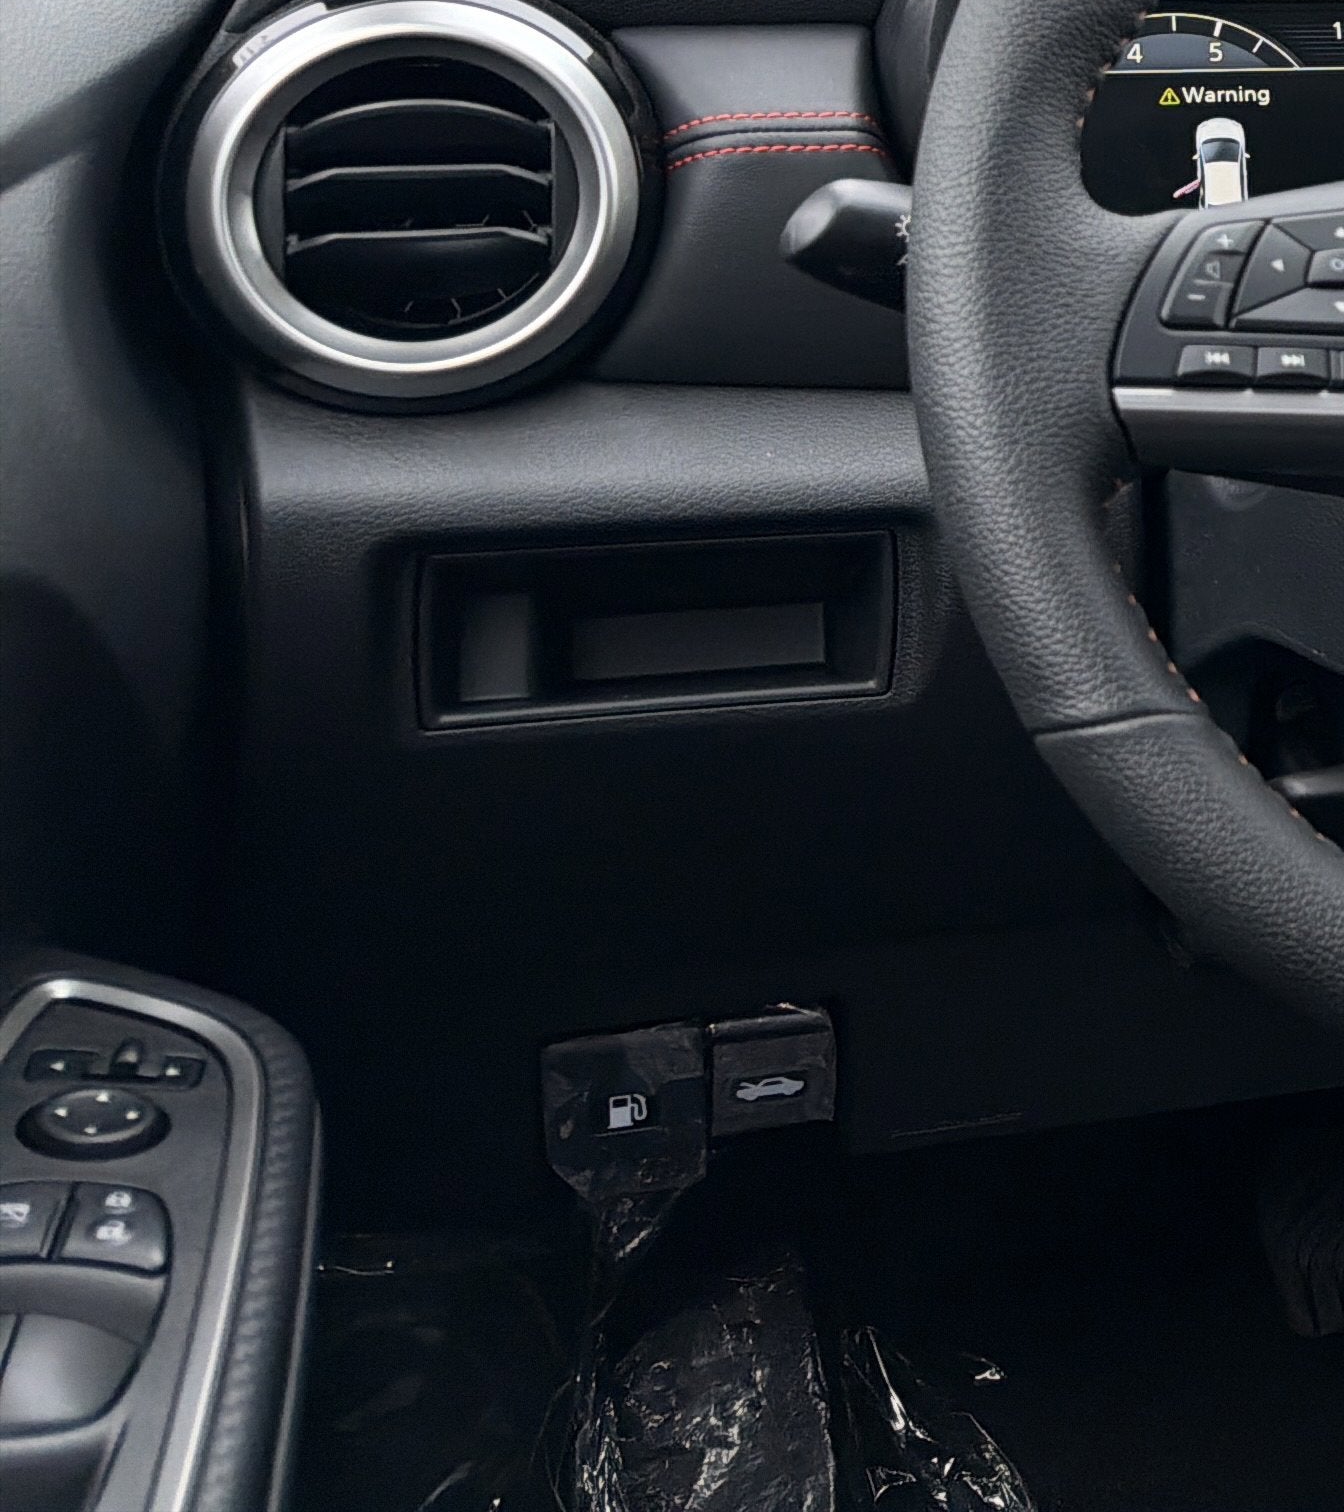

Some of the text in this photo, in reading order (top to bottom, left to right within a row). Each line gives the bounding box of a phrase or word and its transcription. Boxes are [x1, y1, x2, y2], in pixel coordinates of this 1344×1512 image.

[1126, 44, 1143, 63] 4
[1208, 42, 1224, 63] 5
[1181, 87, 1271, 106] Warning
